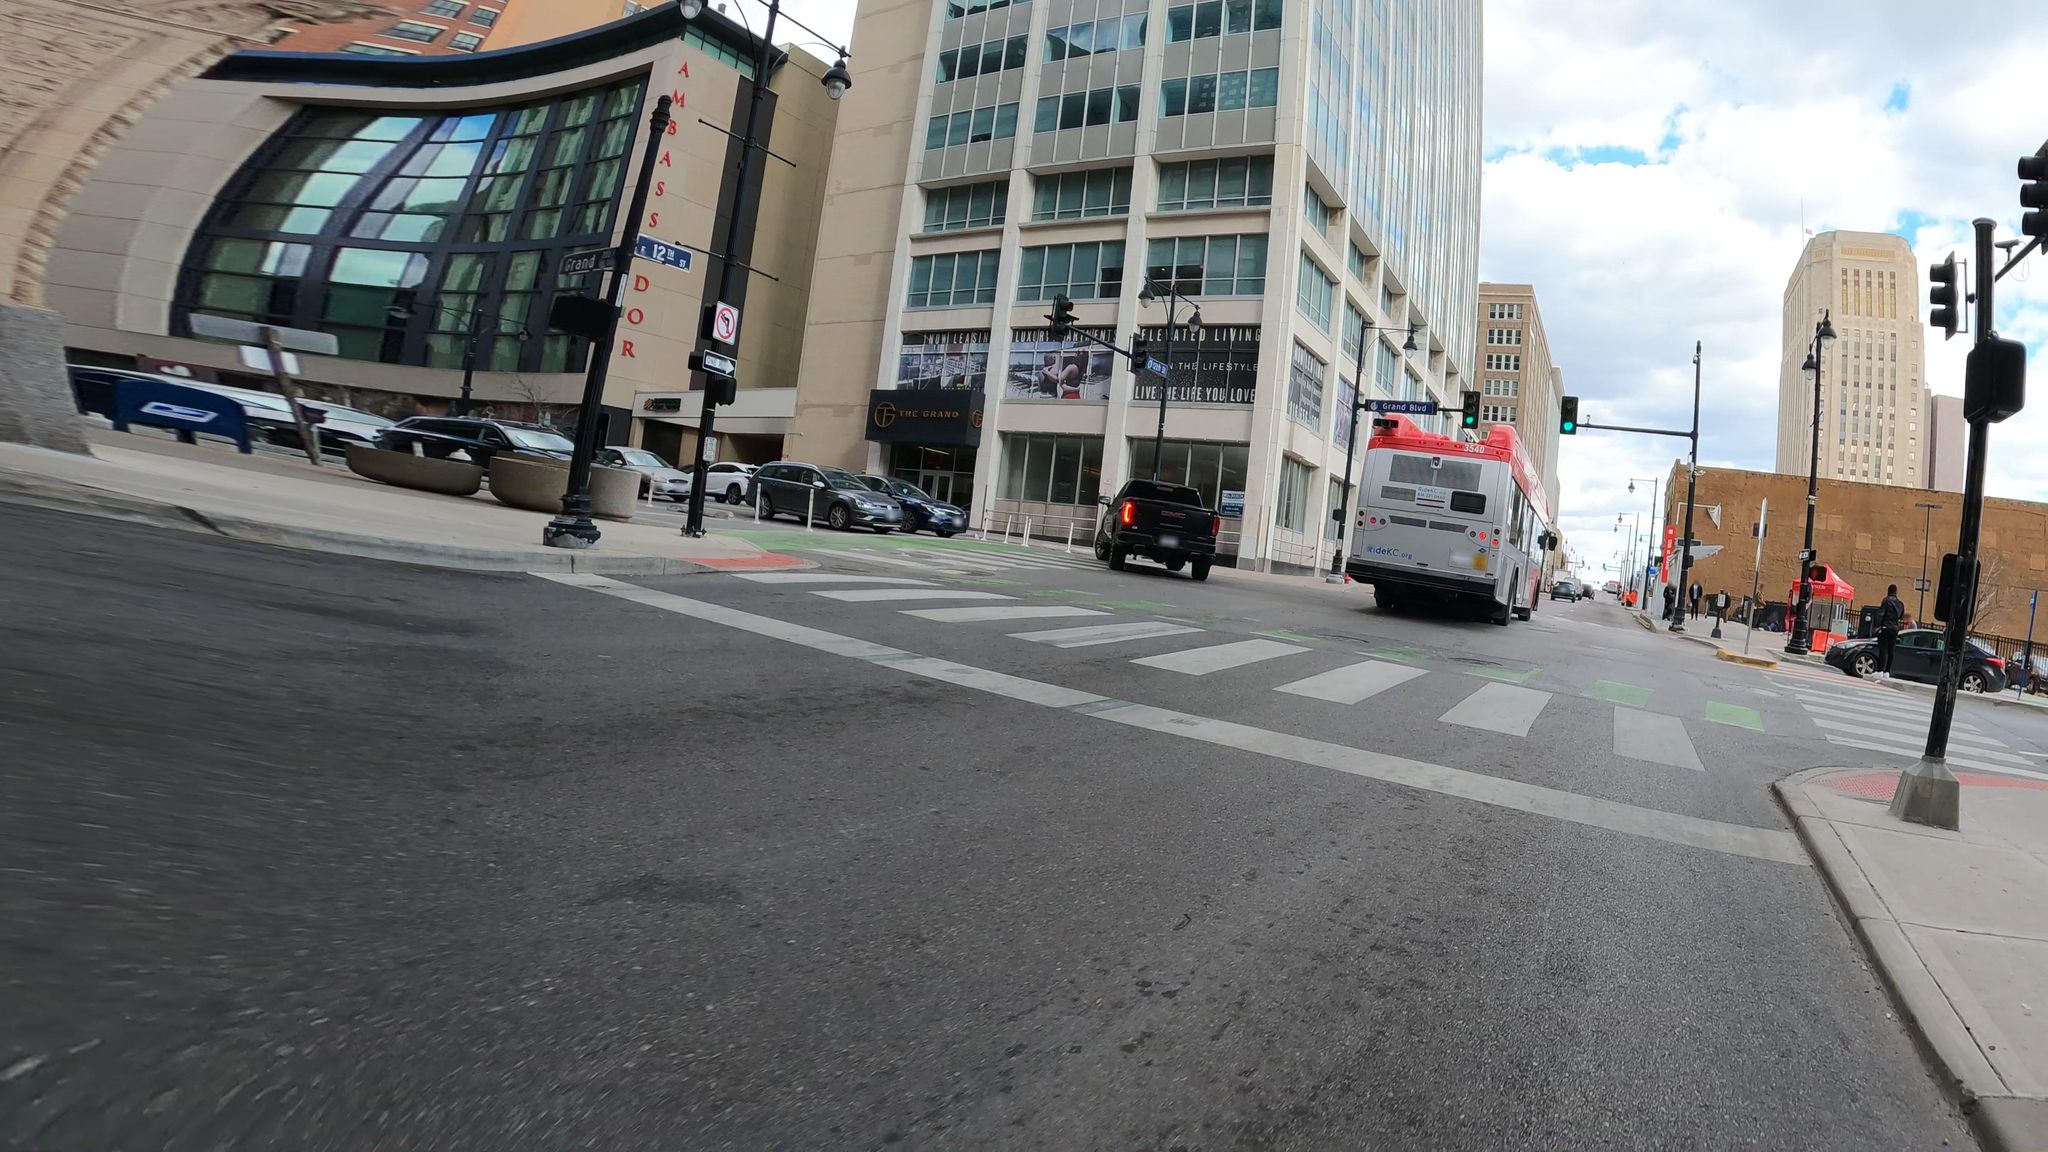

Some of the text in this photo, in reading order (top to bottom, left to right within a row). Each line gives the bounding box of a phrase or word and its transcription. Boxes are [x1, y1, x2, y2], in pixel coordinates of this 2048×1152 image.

[620, 61, 689, 359] AMBASSDOR
[564, 253, 596, 272] Grand
[678, 258, 687, 268] ST
[928, 331, 989, 345] NOW LEASIN
[1140, 326, 1261, 342] ELEATED LIVING
[1178, 361, 1198, 371] THE
[1202, 361, 1258, 372] LIFESTYLE
[1134, 385, 1157, 400] LIVE
[1180, 386, 1203, 401] LIFE
[1206, 387, 1227, 402] YOU
[1230, 387, 1257, 402] LOVE
[1382, 402, 1427, 413] Grand Blvd
[899, 410, 959, 419] THE GRAND
[1463, 443, 1485, 454] 3540
